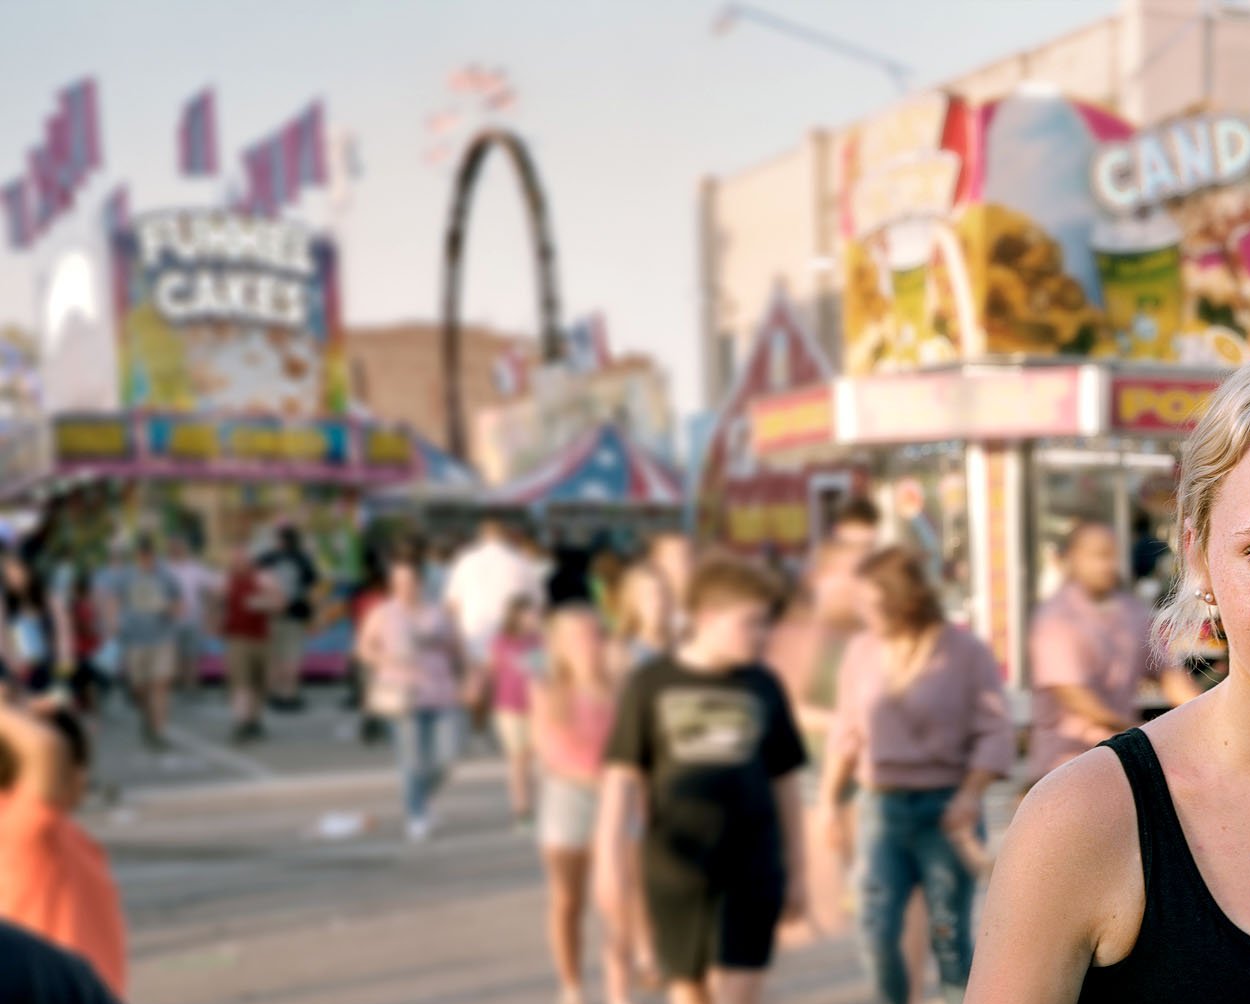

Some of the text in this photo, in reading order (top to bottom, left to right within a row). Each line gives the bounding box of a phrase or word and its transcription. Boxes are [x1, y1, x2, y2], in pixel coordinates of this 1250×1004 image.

[143, 208, 315, 274] FUNNEL
[156, 273, 305, 323] CAKES
[1120, 386, 1218, 424] PO
